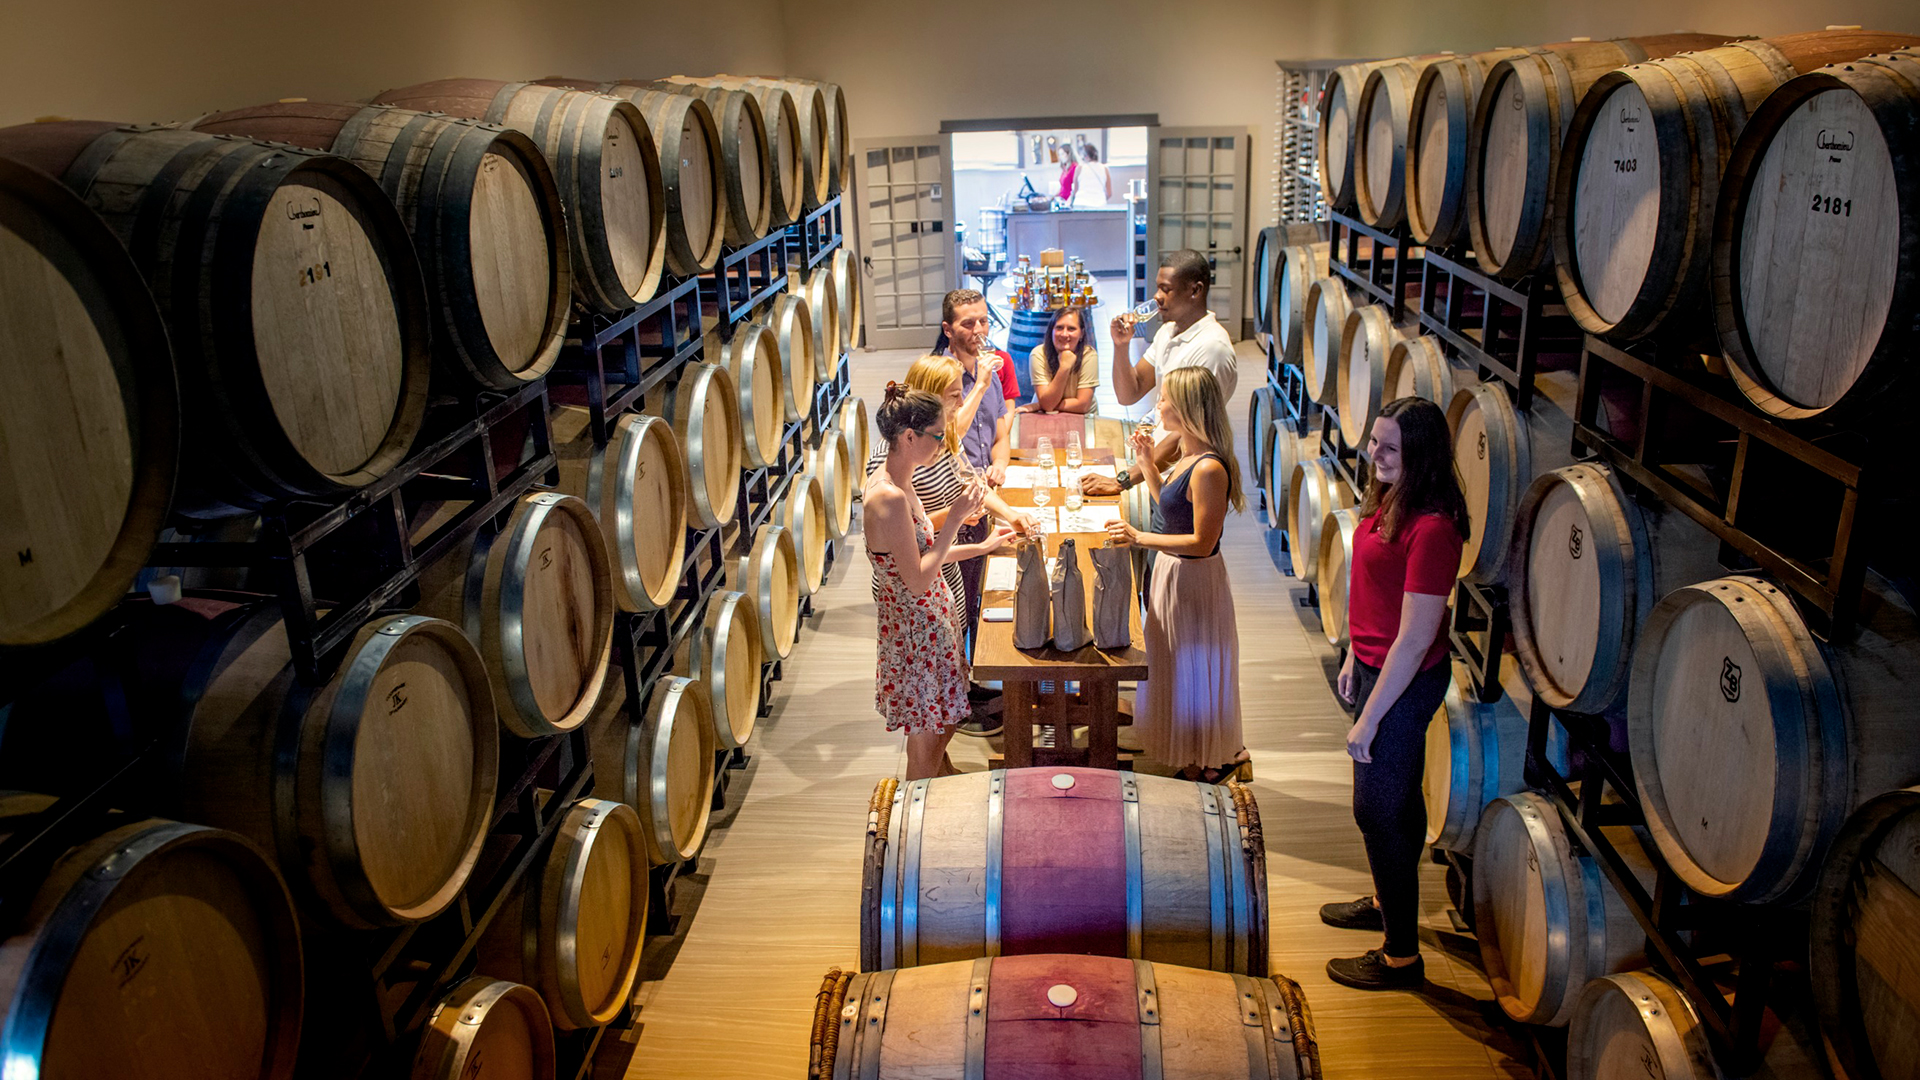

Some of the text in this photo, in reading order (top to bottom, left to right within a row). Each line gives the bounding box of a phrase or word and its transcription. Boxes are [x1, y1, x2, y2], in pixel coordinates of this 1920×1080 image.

[1614, 159, 1637, 173] 7403
[1811, 194, 1852, 217] 2181
[18, 547, 32, 566] M
